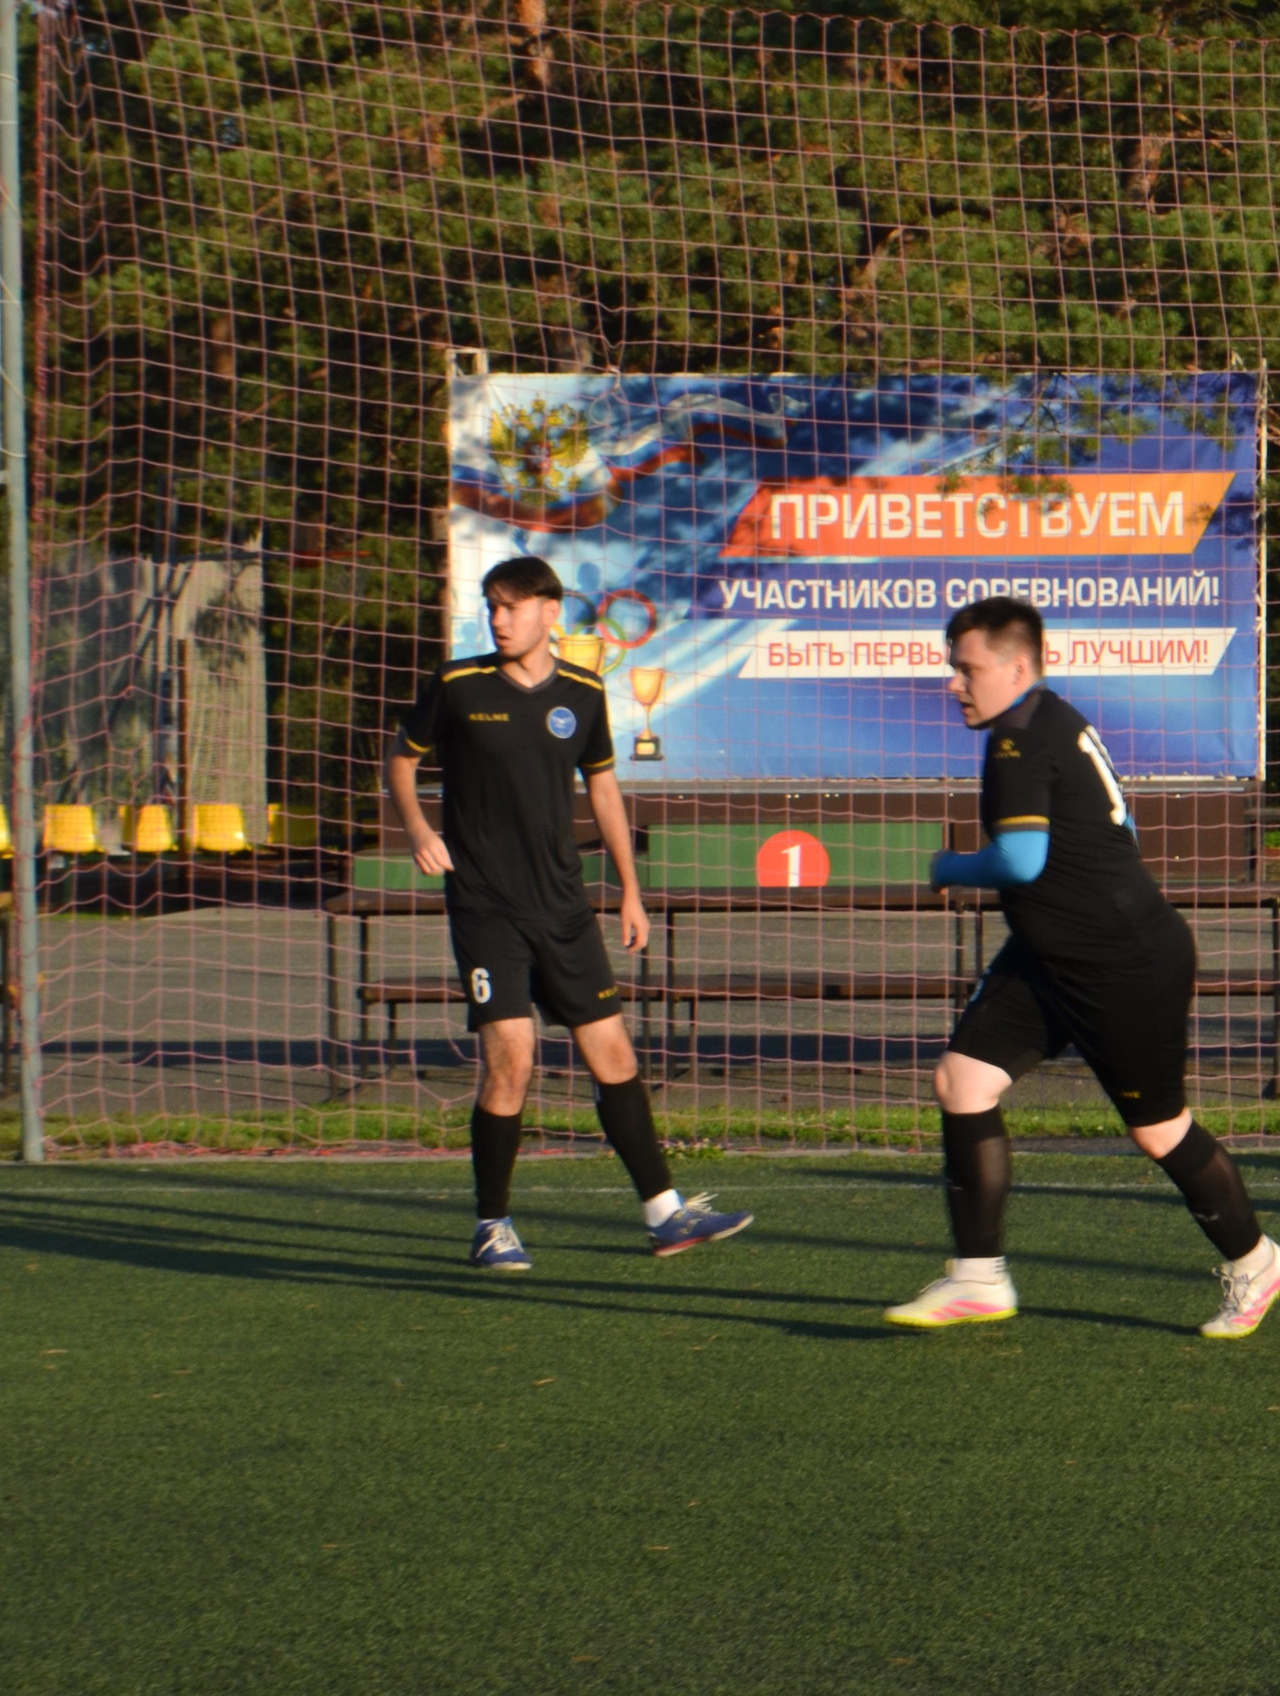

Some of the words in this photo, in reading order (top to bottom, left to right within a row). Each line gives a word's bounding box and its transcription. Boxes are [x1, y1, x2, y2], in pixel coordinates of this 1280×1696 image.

[771, 490, 1184, 539] ПРИВЕТСТВУЕМ
[719, 578, 937, 610] УЧАСТНИКОВ
[945, 569, 1220, 609] СОРЕВНОВАНИЙ!
[768, 642, 845, 667] БЫТЬ
[853, 641, 950, 666] ПЕРВЫ
[1069, 639, 1209, 665] ЛУЧШИМ!
[1077, 724, 1127, 826] 1
[780, 843, 801, 888] 1
[471, 967, 492, 1003] 6
